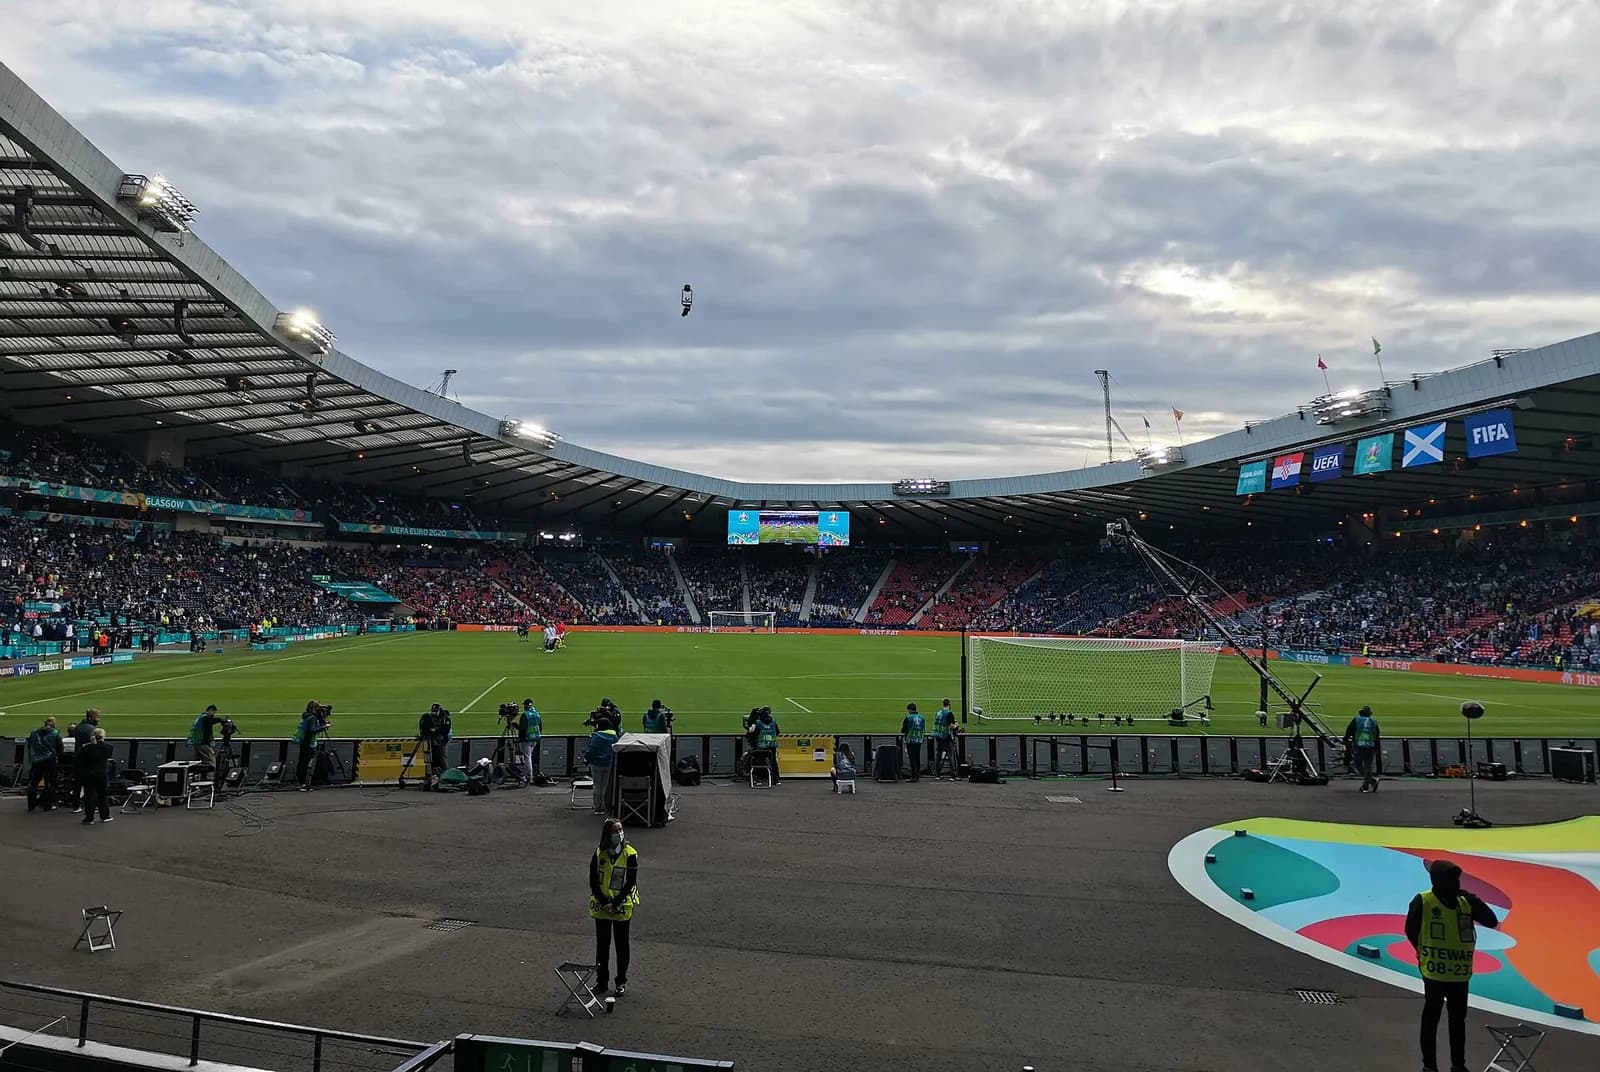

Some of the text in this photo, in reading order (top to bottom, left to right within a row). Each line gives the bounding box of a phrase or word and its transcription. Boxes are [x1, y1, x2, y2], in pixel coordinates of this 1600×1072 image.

[1472, 422, 1509, 446] FIFA
[1313, 454, 1339, 471] UEFA
[145, 497, 185, 510] GLASGOW
[390, 526, 408, 535] UEFA
[1296, 653, 1329, 665] GLASGOW
[1375, 659, 1394, 670] JUST
[1422, 945, 1473, 961] STEWAR
[1426, 961, 1473, 976] 08-23
